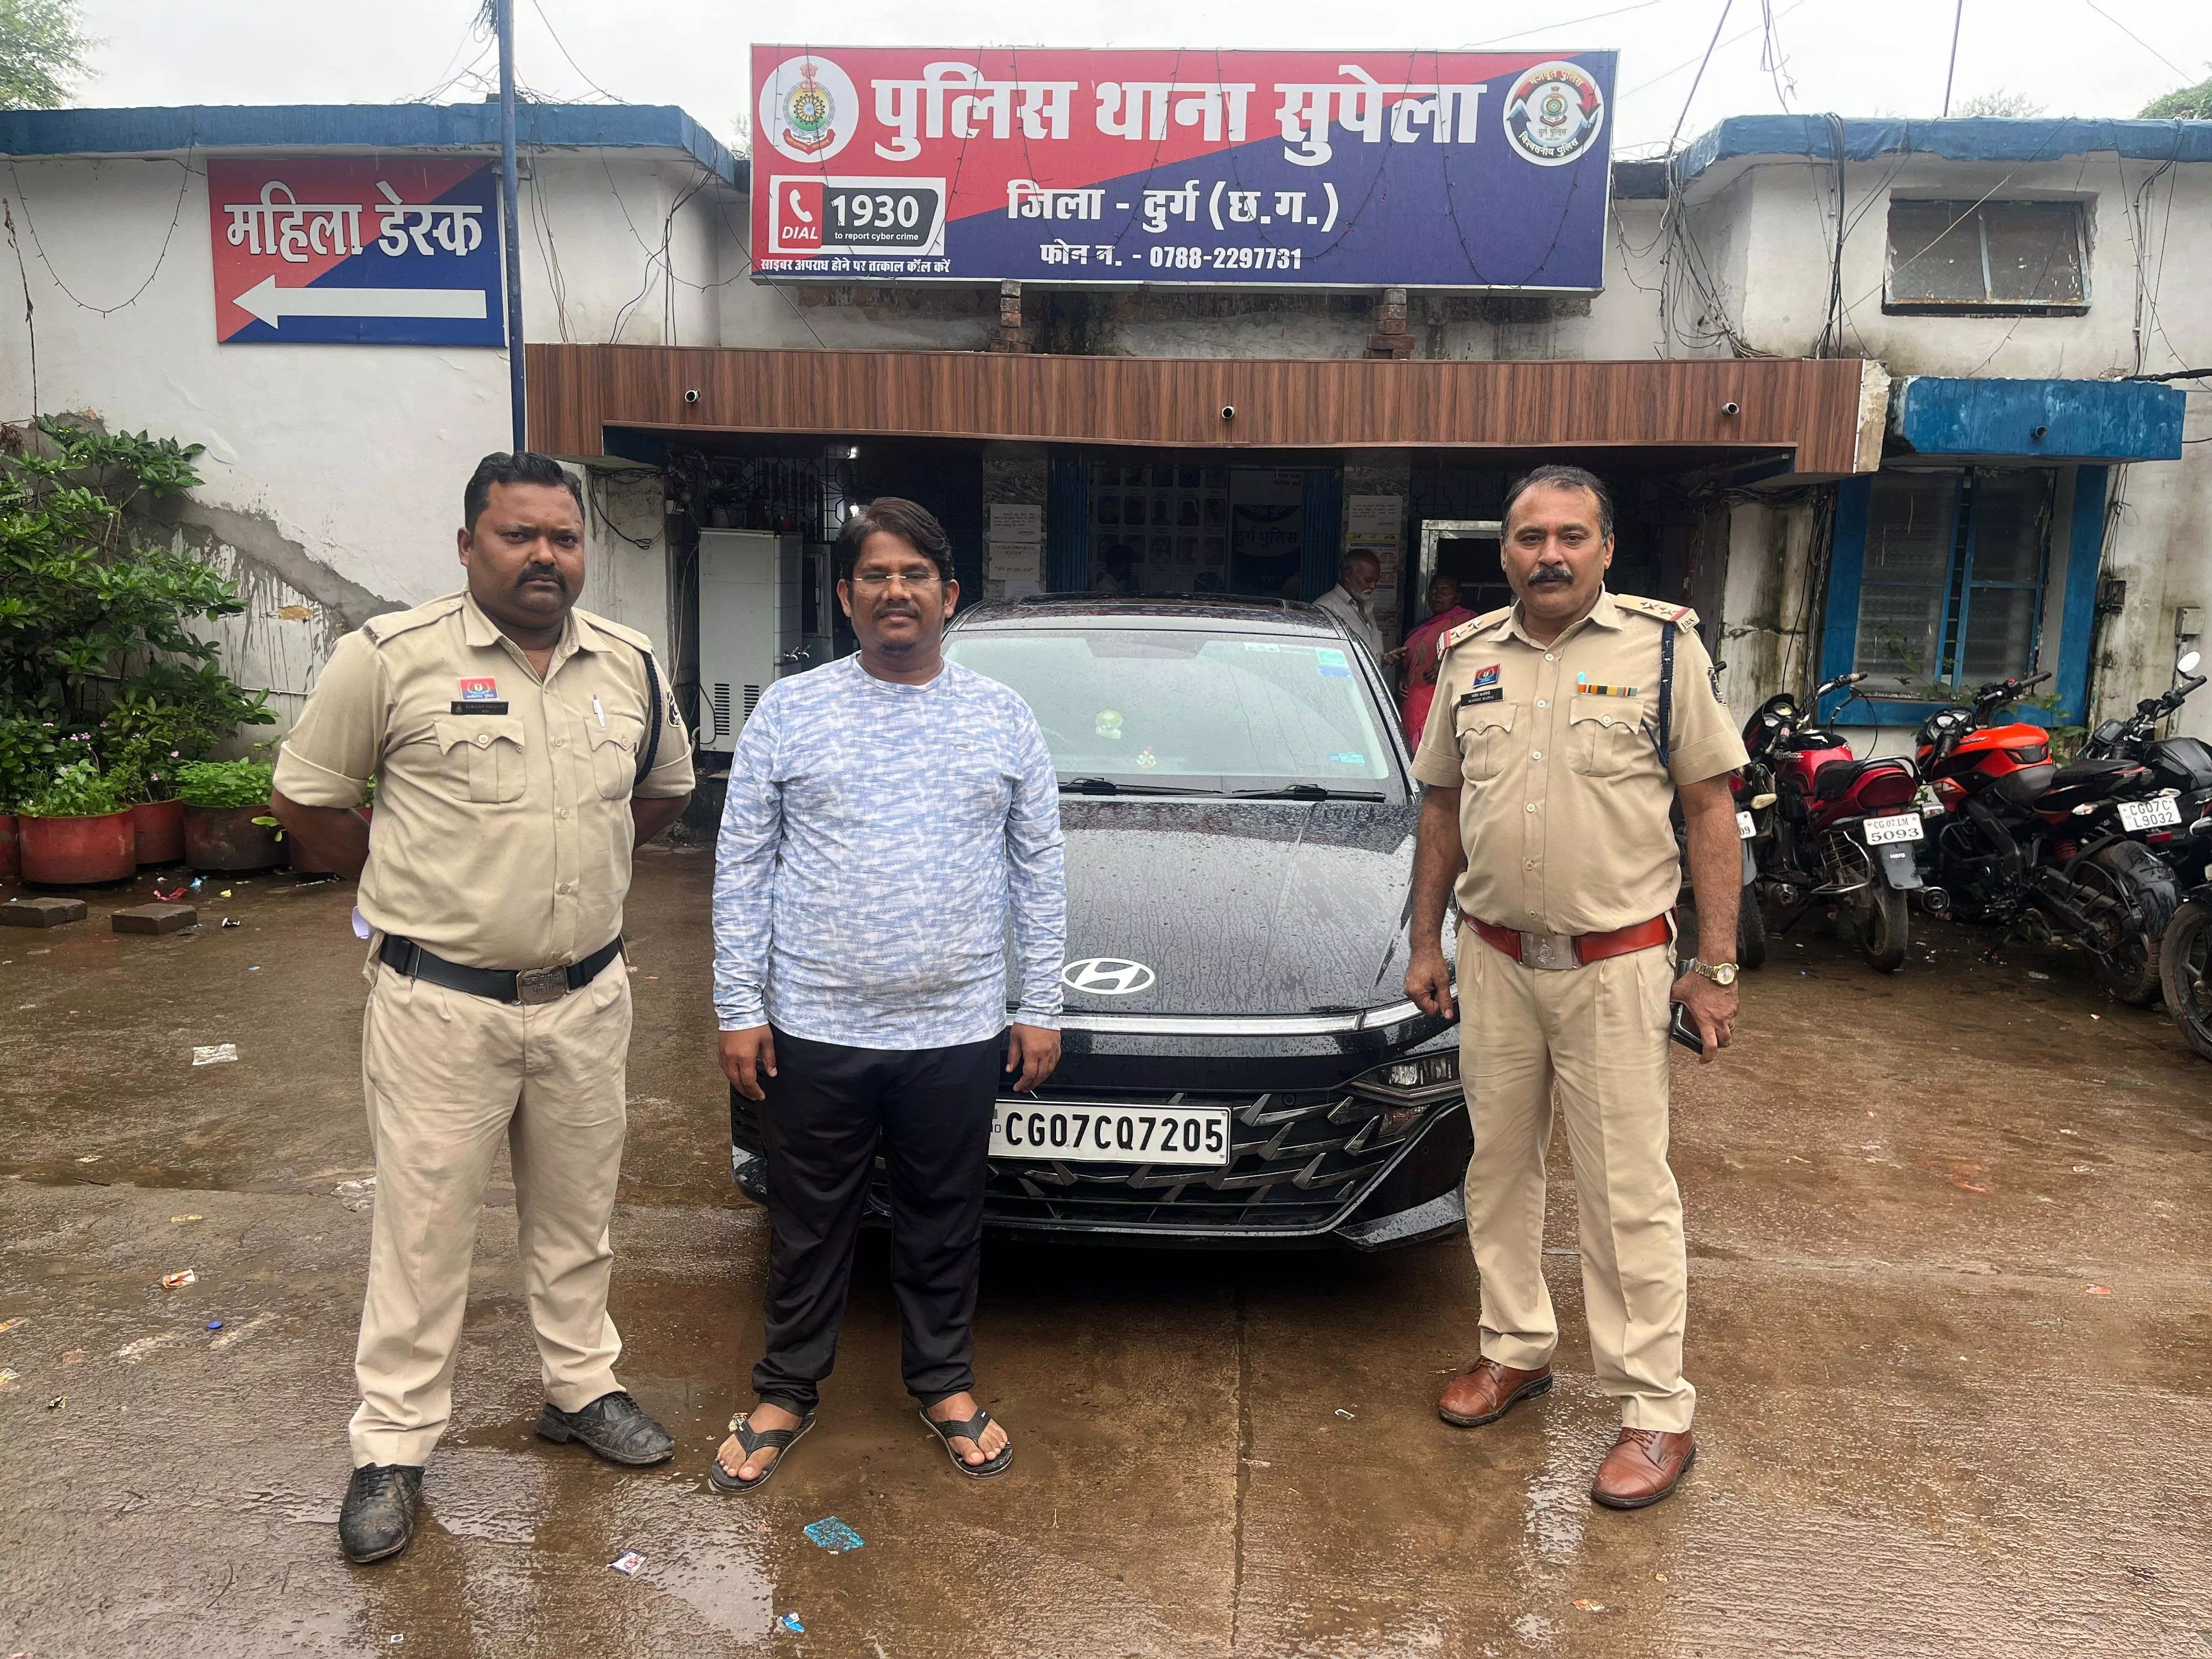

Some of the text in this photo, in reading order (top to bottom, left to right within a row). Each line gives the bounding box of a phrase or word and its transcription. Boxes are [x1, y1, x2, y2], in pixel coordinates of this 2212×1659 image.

[1560, 70, 1584, 86] पुलिस
[871, 61, 1488, 166] पुलिस थाना सुपेला
[1550, 127, 1567, 137] पुलिस
[1556, 138, 1579, 156] पुलिस
[831, 194, 919, 228] 1930
[1007, 179, 1105, 219] जिला
[1142, 180, 1200, 233] दुर्ग
[1209, 181, 1339, 232] (छ.ग.)
[224, 179, 483, 263] महिला डेस्क
[781, 227, 819, 240] DIAL
[845, 233, 870, 241] report
[871, 233, 895, 241] cyber
[1040, 238, 1090, 265] फोन
[1150, 246, 1301, 269] 0788-2297731
[760, 259, 793, 271] साइबर
[795, 259, 828, 271] अपराध
[831, 257, 850, 272] होने
[853, 261, 866, 272] पर
[906, 258, 932, 273] कॉल
[934, 259, 951, 273] करें
[1260, 527, 1298, 547] पुलिस
[2130, 800, 2170, 815] CG07C
[2134, 812, 2174, 827] L9032
[1871, 828, 1919, 842] 5093
[1006, 1111, 1223, 1153] CG07CQ7205
